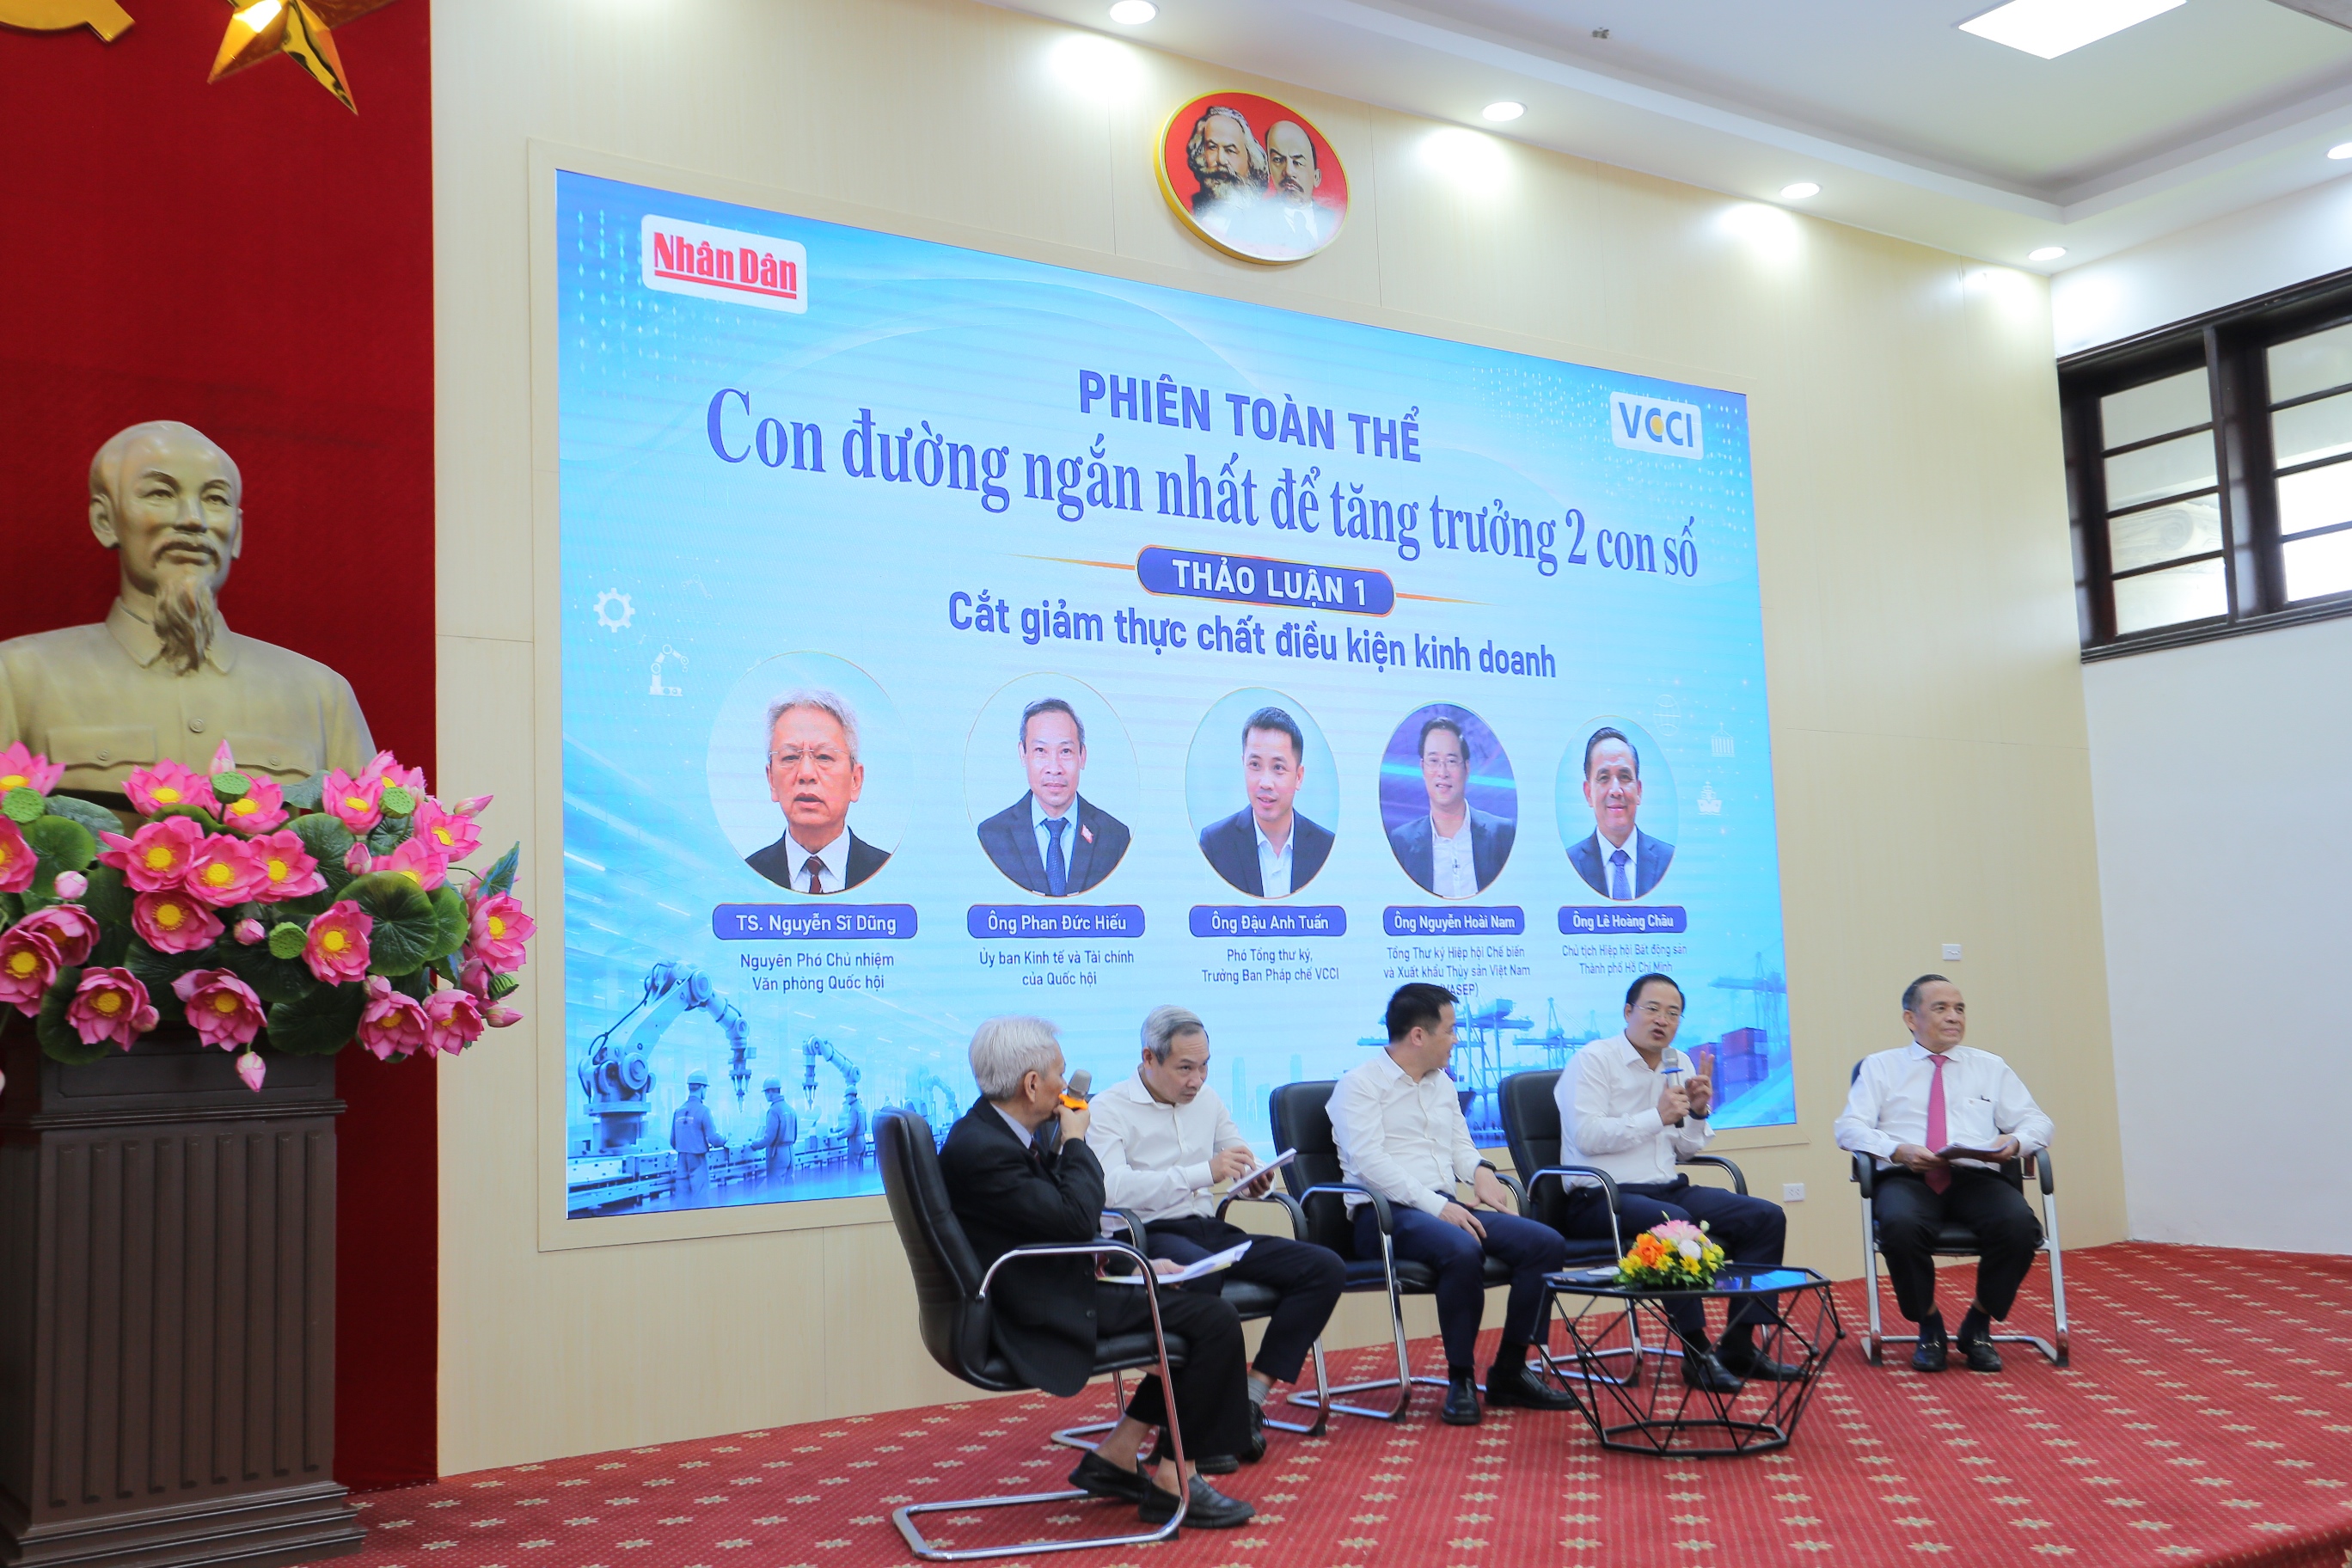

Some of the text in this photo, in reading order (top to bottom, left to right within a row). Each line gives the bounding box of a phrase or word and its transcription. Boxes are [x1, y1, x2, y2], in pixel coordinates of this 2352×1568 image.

[653, 232, 797, 292] Nhân Dân
[1080, 369, 1421, 462] PHIÊN TOÀN THỂ
[1618, 401, 1694, 448] VCCI
[707, 387, 1699, 578] Con đường ngắn nhất để tăng trưởng 2 con số
[1172, 556, 1366, 607] THẢO LUẬN 1
[948, 589, 1556, 677] Cắt giảm thực chất điều kiện kinh doanh
[736, 913, 897, 936] TS. Nguyễn Sĩ Dũng
[988, 910, 1127, 934] Ông Phan Đức Hiếu
[1211, 910, 1329, 934] Ông Đậu Anh Tuấn
[1393, 910, 1516, 933] Ông Nguyễn Hoài Nam
[1572, 910, 1674, 932] Ông Lê Hoàng Châu
[740, 952, 894, 971] Nguyên Phó Chủ nhiệm
[979, 947, 1135, 968] Ủy ban Kinh tế và Tài chính
[1227, 948, 1247, 962] Phó
[1278, 948, 1296, 961] thư
[1299, 947, 1314, 963] ký,
[1413, 946, 1431, 959] Thư
[1435, 946, 1445, 961] ký
[1448, 946, 1468, 961] Hiệp
[1471, 946, 1485, 960] hội
[1486, 945, 1504, 958] Chế
[1506, 945, 1525, 958] biến
[1562, 943, 1579, 957] Chủ
[1581, 946, 1597, 959] tịch
[1600, 945, 1618, 959] Hiệp
[1620, 945, 1632, 958] hội
[1651, 944, 1670, 958] động
[1022, 971, 1097, 988] của Quốc hội
[1202, 966, 1339, 984] Trưởng Ban Pháp chế VCCI
[1383, 967, 1394, 979] và
[1397, 965, 1419, 978] Xuất
[1472, 964, 1487, 977] sản
[1490, 965, 1508, 978] Việt
[1510, 965, 1531, 976] Nam
[1579, 962, 1605, 975] Thành
[753, 974, 885, 994] Văn phòng Quốc hội
